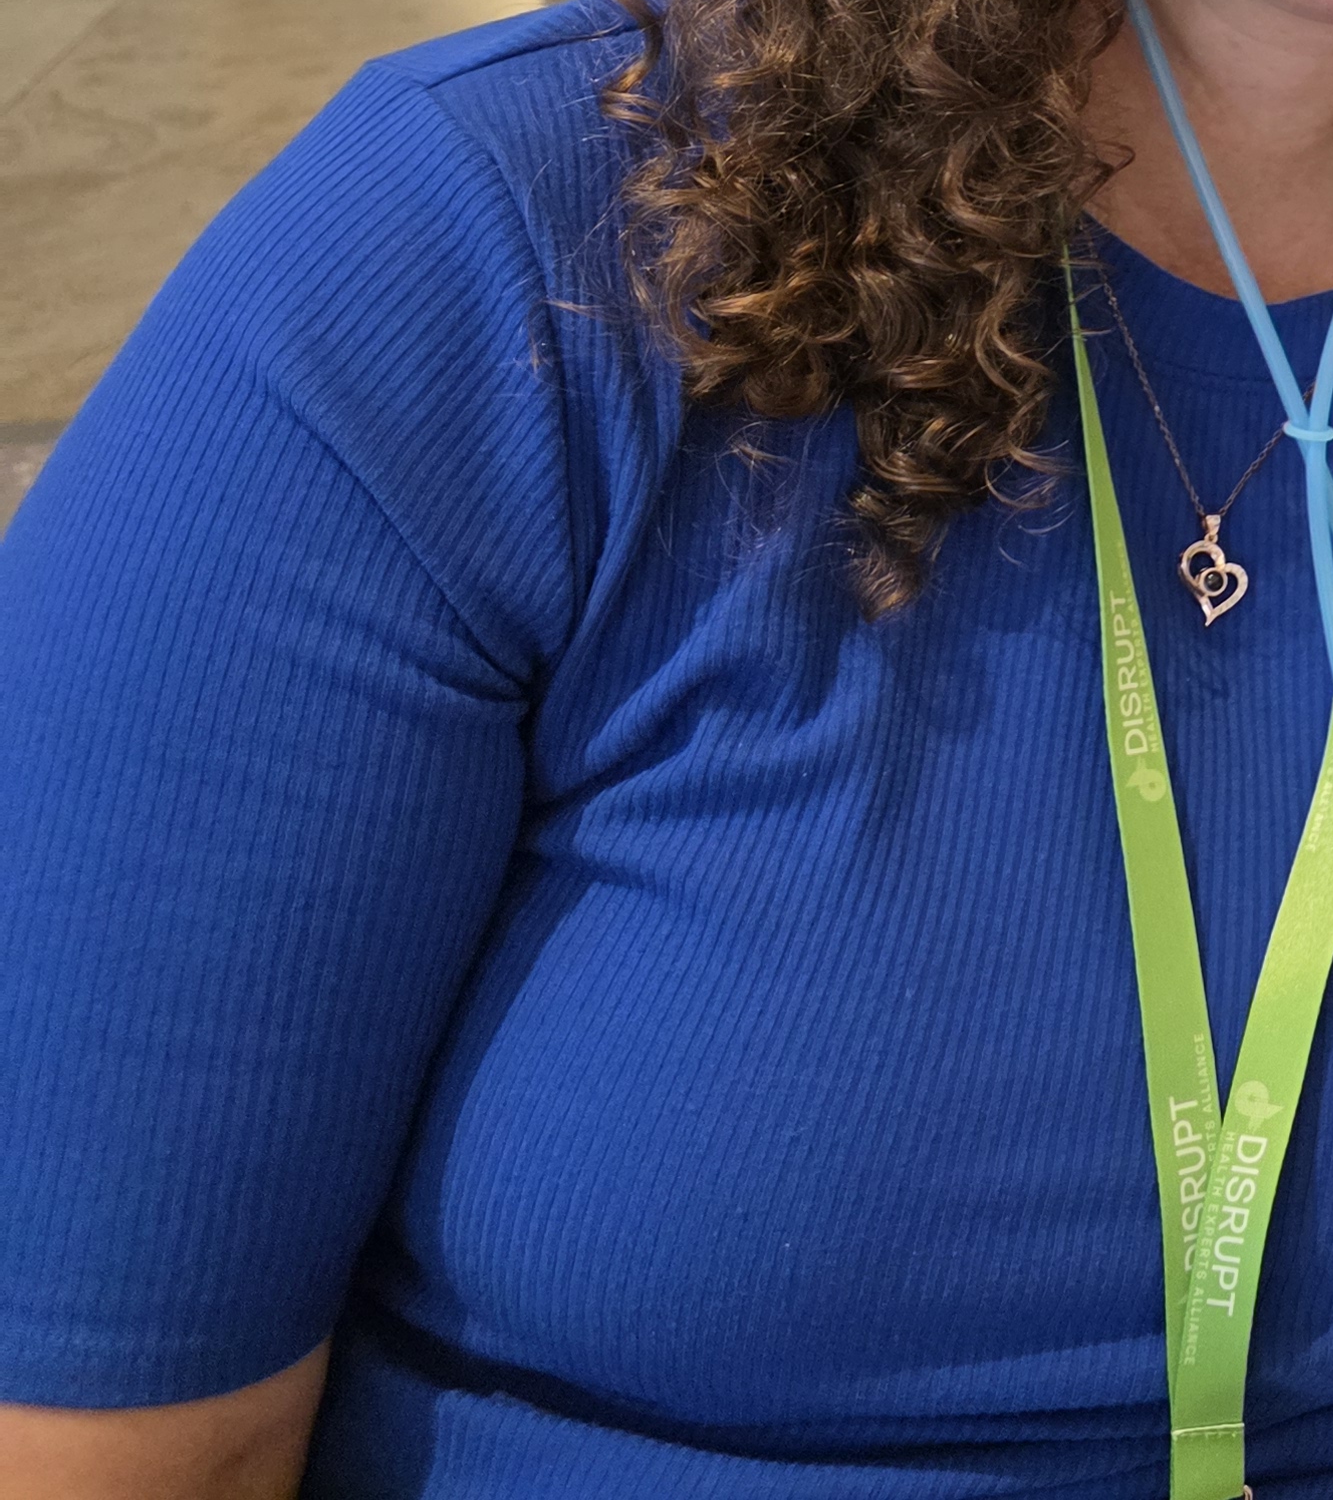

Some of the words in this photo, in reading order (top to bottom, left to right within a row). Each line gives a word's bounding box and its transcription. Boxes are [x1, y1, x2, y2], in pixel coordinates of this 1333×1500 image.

[1110, 589, 1150, 756] DISRUPT
[1193, 1033, 1213, 1113] ALLIANCE
[1211, 1131, 1237, 1197] HEALTH
[1195, 1203, 1219, 1280] EXPERTS
[1206, 1133, 1269, 1317] DISRUPT
[1184, 1286, 1205, 1366] ALLIANCE
